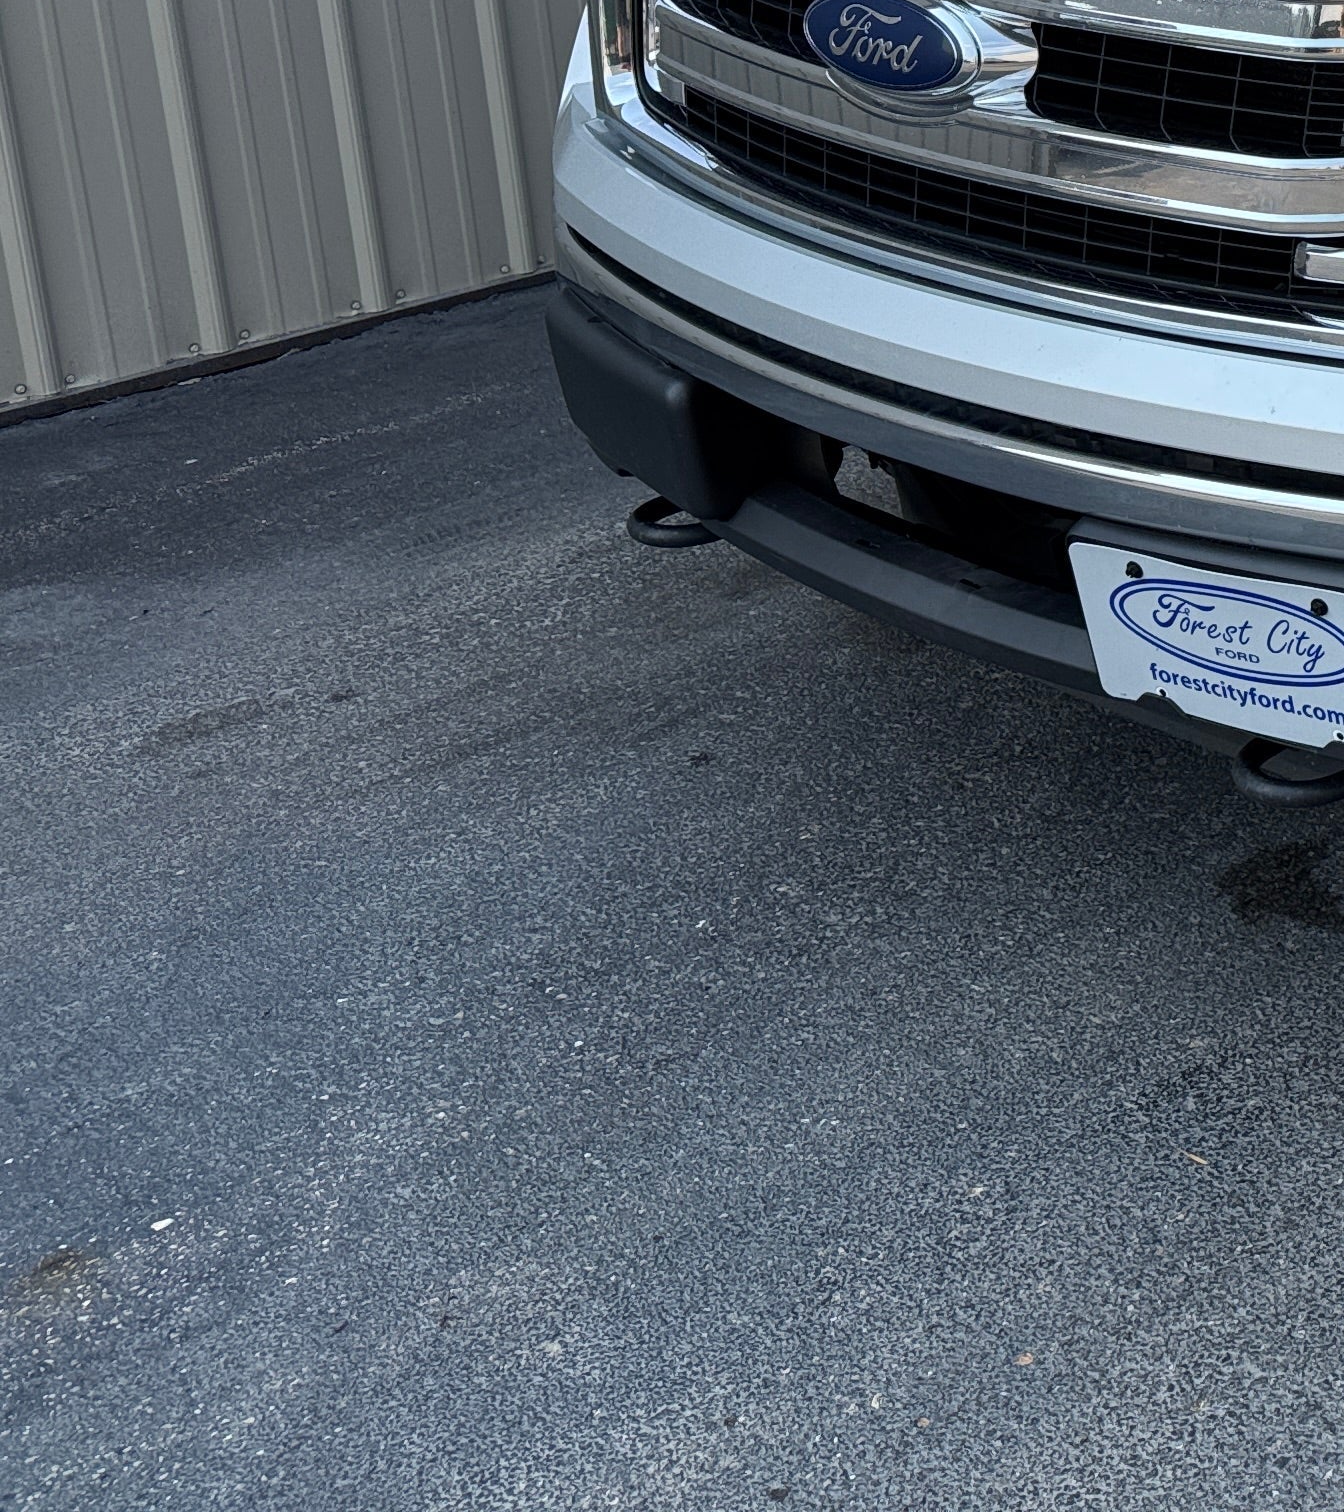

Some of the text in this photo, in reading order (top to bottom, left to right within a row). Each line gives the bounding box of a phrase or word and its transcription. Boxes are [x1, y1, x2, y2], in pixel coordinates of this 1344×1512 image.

[828, 3, 924, 73] Ford
[1152, 592, 1326, 673] Forest City
[1214, 646, 1260, 665] FORD
